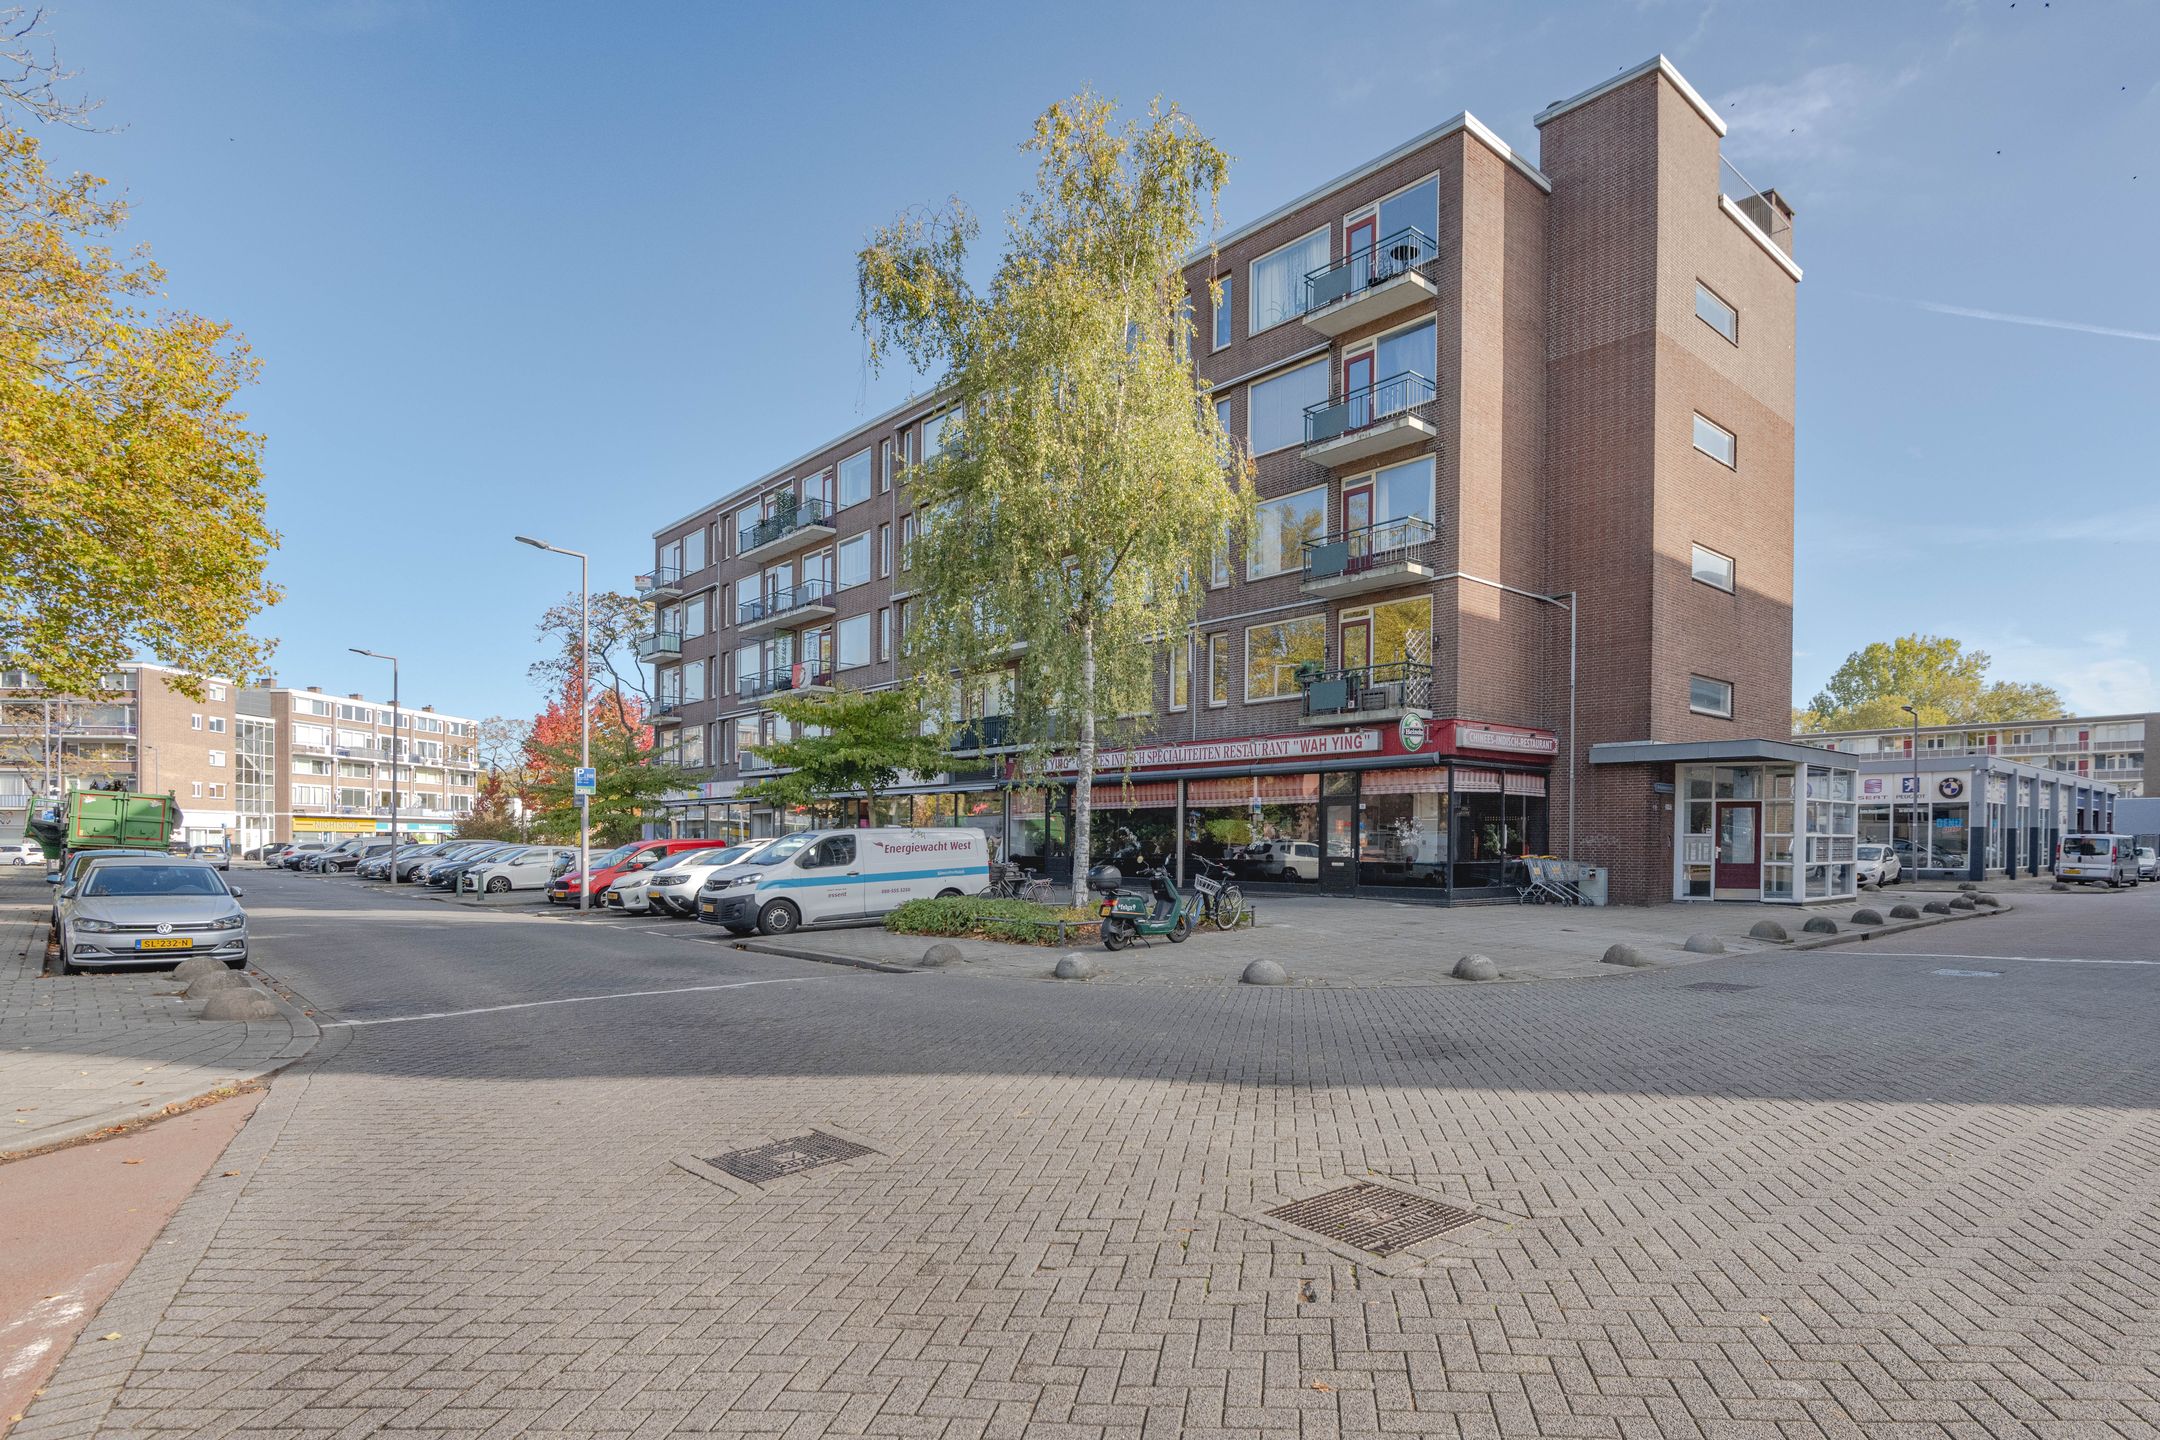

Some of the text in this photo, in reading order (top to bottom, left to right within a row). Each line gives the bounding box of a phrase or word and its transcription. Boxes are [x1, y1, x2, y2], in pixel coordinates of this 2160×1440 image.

[1112, 752, 1145, 766] INDCH
[1148, 746, 1221, 763] SPECIALITEITEN
[1223, 740, 1290, 758] RESTAURANT
[1293, 738, 1327, 752] "WAH
[1331, 734, 1370, 750] YING"
[314, 821, 359, 830] NIGHTSHOP
[884, 841, 971, 855] Energiewacht West
[144, 940, 188, 948] SL-232-N
